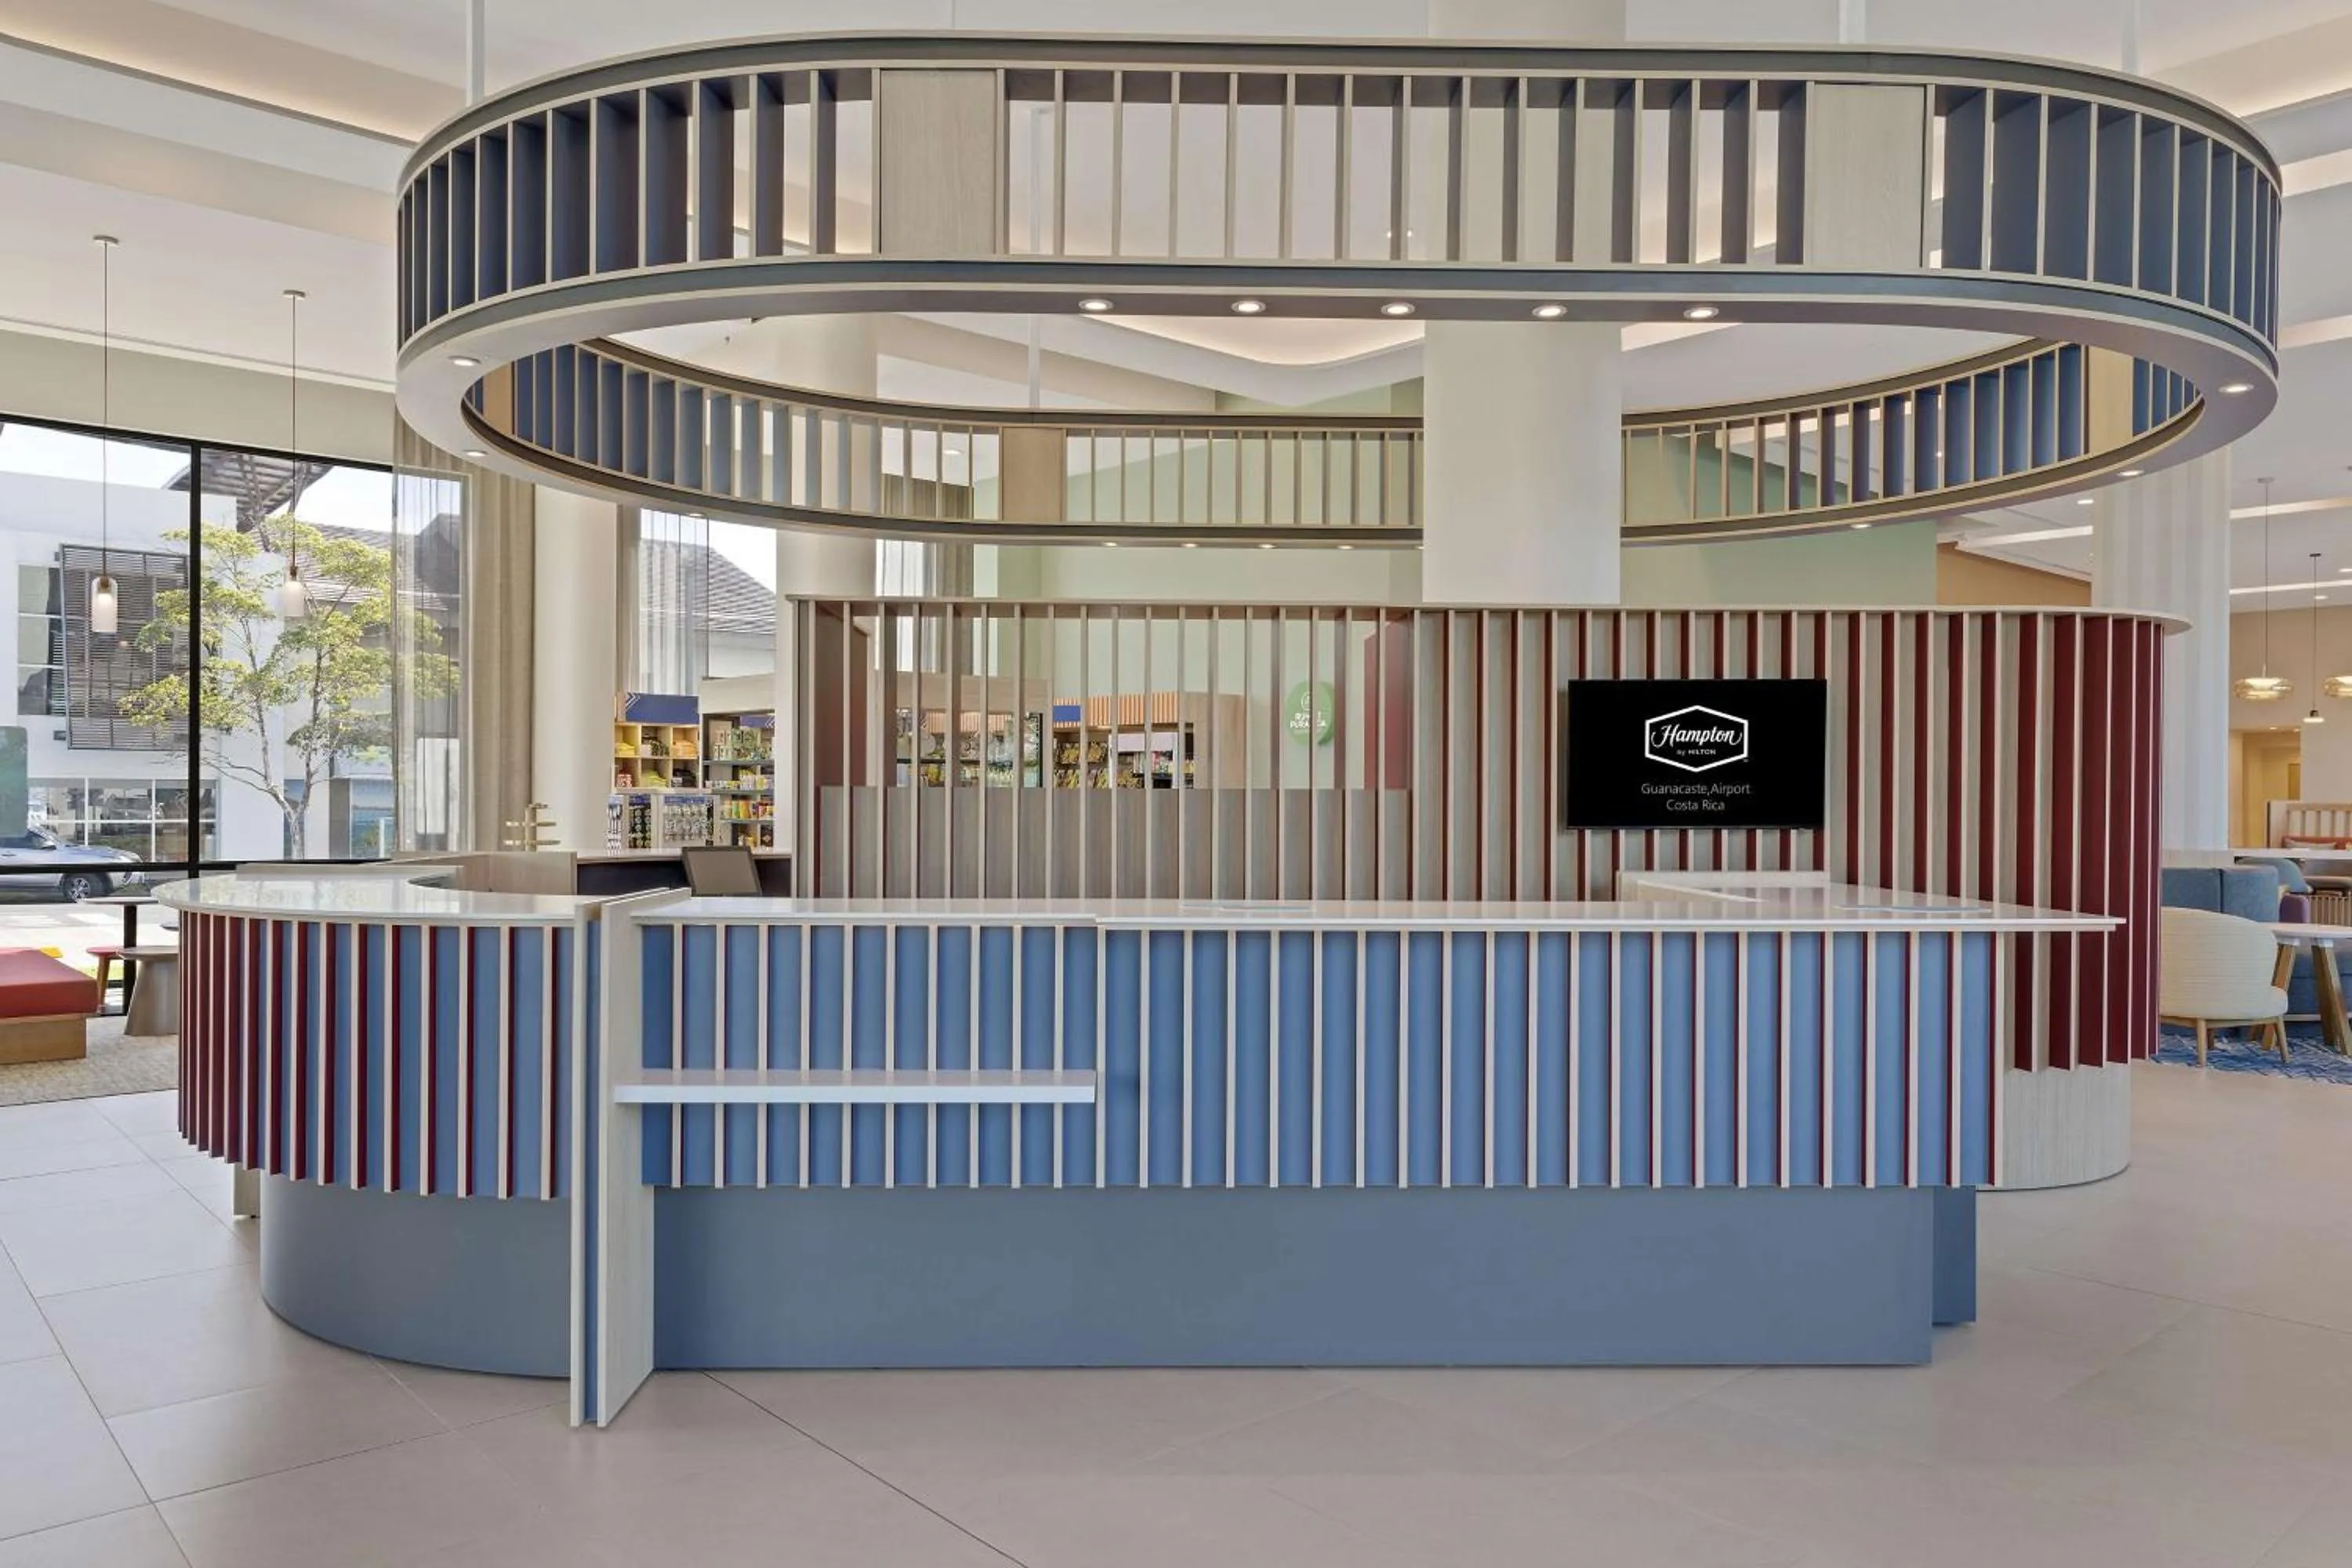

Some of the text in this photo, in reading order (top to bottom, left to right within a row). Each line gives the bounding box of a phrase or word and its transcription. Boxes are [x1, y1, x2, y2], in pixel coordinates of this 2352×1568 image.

[1650, 724, 1742, 747] Hampton
[1666, 799, 1726, 811] Costa Rica
